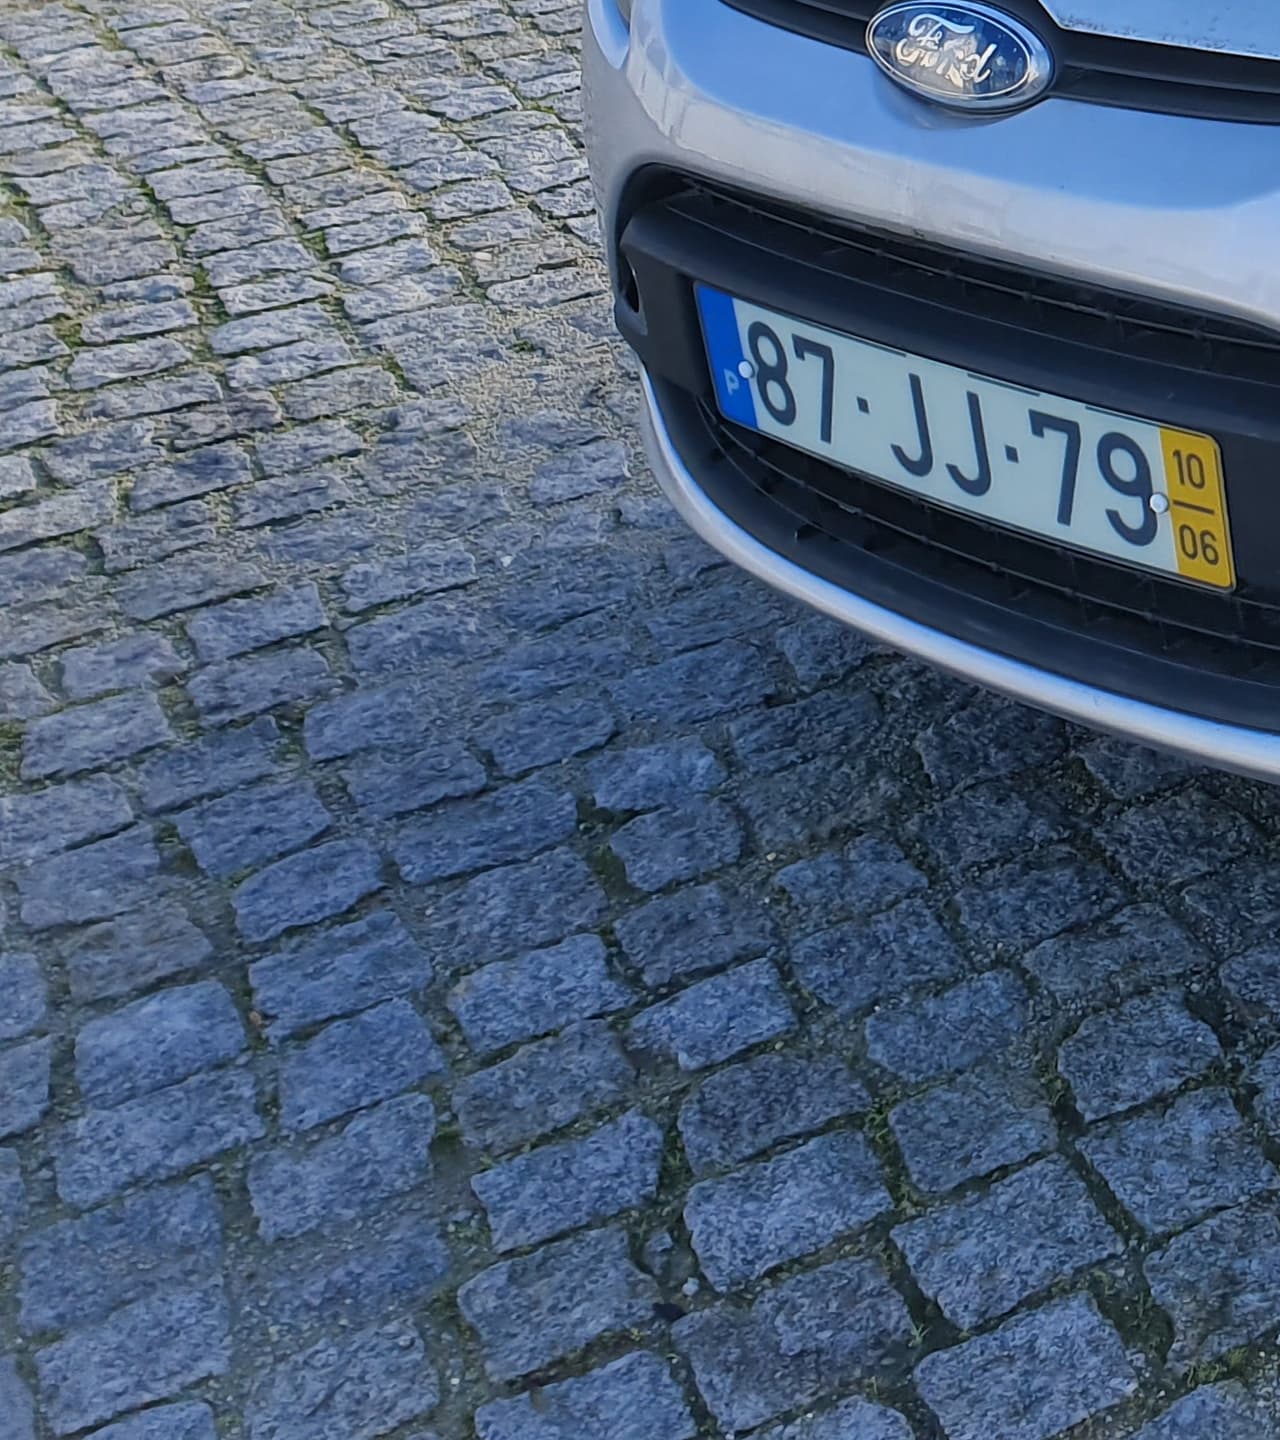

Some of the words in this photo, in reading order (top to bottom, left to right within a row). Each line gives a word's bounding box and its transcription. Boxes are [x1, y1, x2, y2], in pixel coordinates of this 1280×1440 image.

[895, 13, 998, 86] Ford
[723, 367, 740, 396] P
[1172, 448, 1206, 490] 10
[1178, 523, 1220, 566] 06
